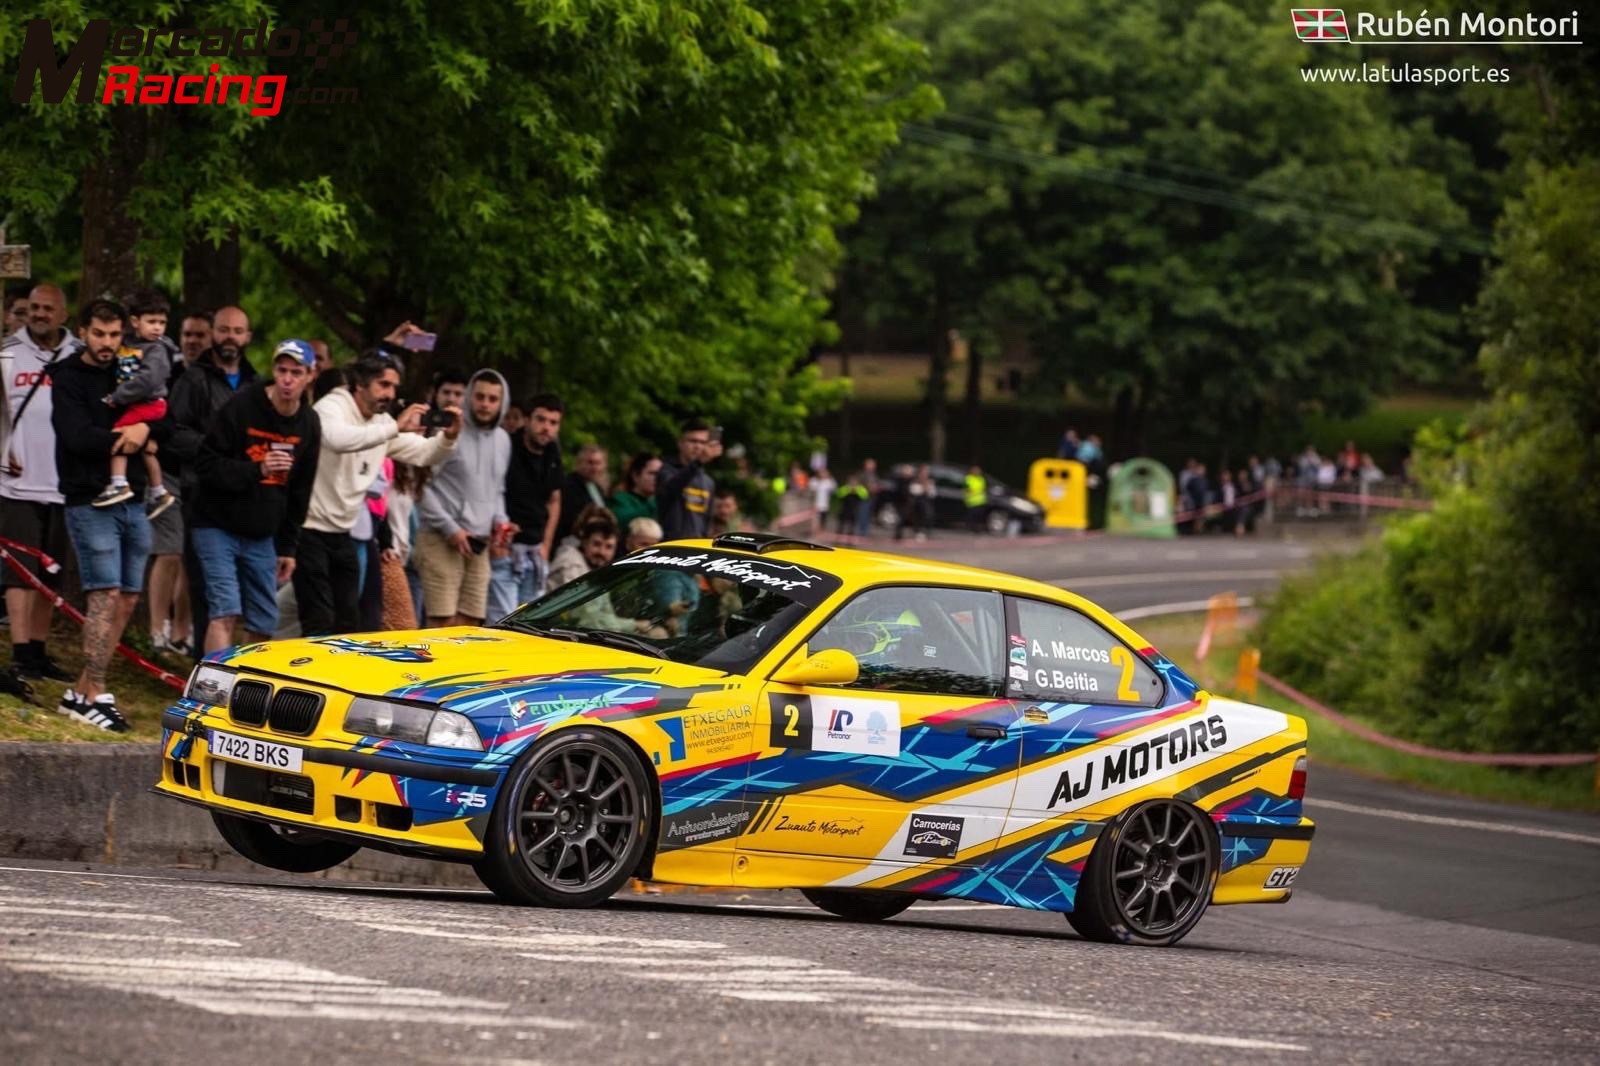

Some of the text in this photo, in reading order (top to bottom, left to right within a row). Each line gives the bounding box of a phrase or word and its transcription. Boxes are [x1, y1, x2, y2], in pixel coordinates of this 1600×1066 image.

[702, 558, 811, 590] Motorsport
[1032, 639, 1049, 657] A.
[1052, 643, 1110, 663] Marcos
[1035, 669, 1098, 692] G.Beitia
[1111, 646, 1140, 702] 2
[683, 704, 752, 728] ETXEGAUR
[784, 704, 800, 736] 2
[690, 720, 750, 739] INMOBILIARIA
[827, 730, 851, 740] Petronor
[218, 735, 289, 766] 7422 BKS
[1047, 715, 1227, 809] AJ MOTORS
[774, 814, 865, 838] Zuauto Motorsport
[913, 817, 961, 831] Carrocerías
[1264, 867, 1300, 887] GT2
